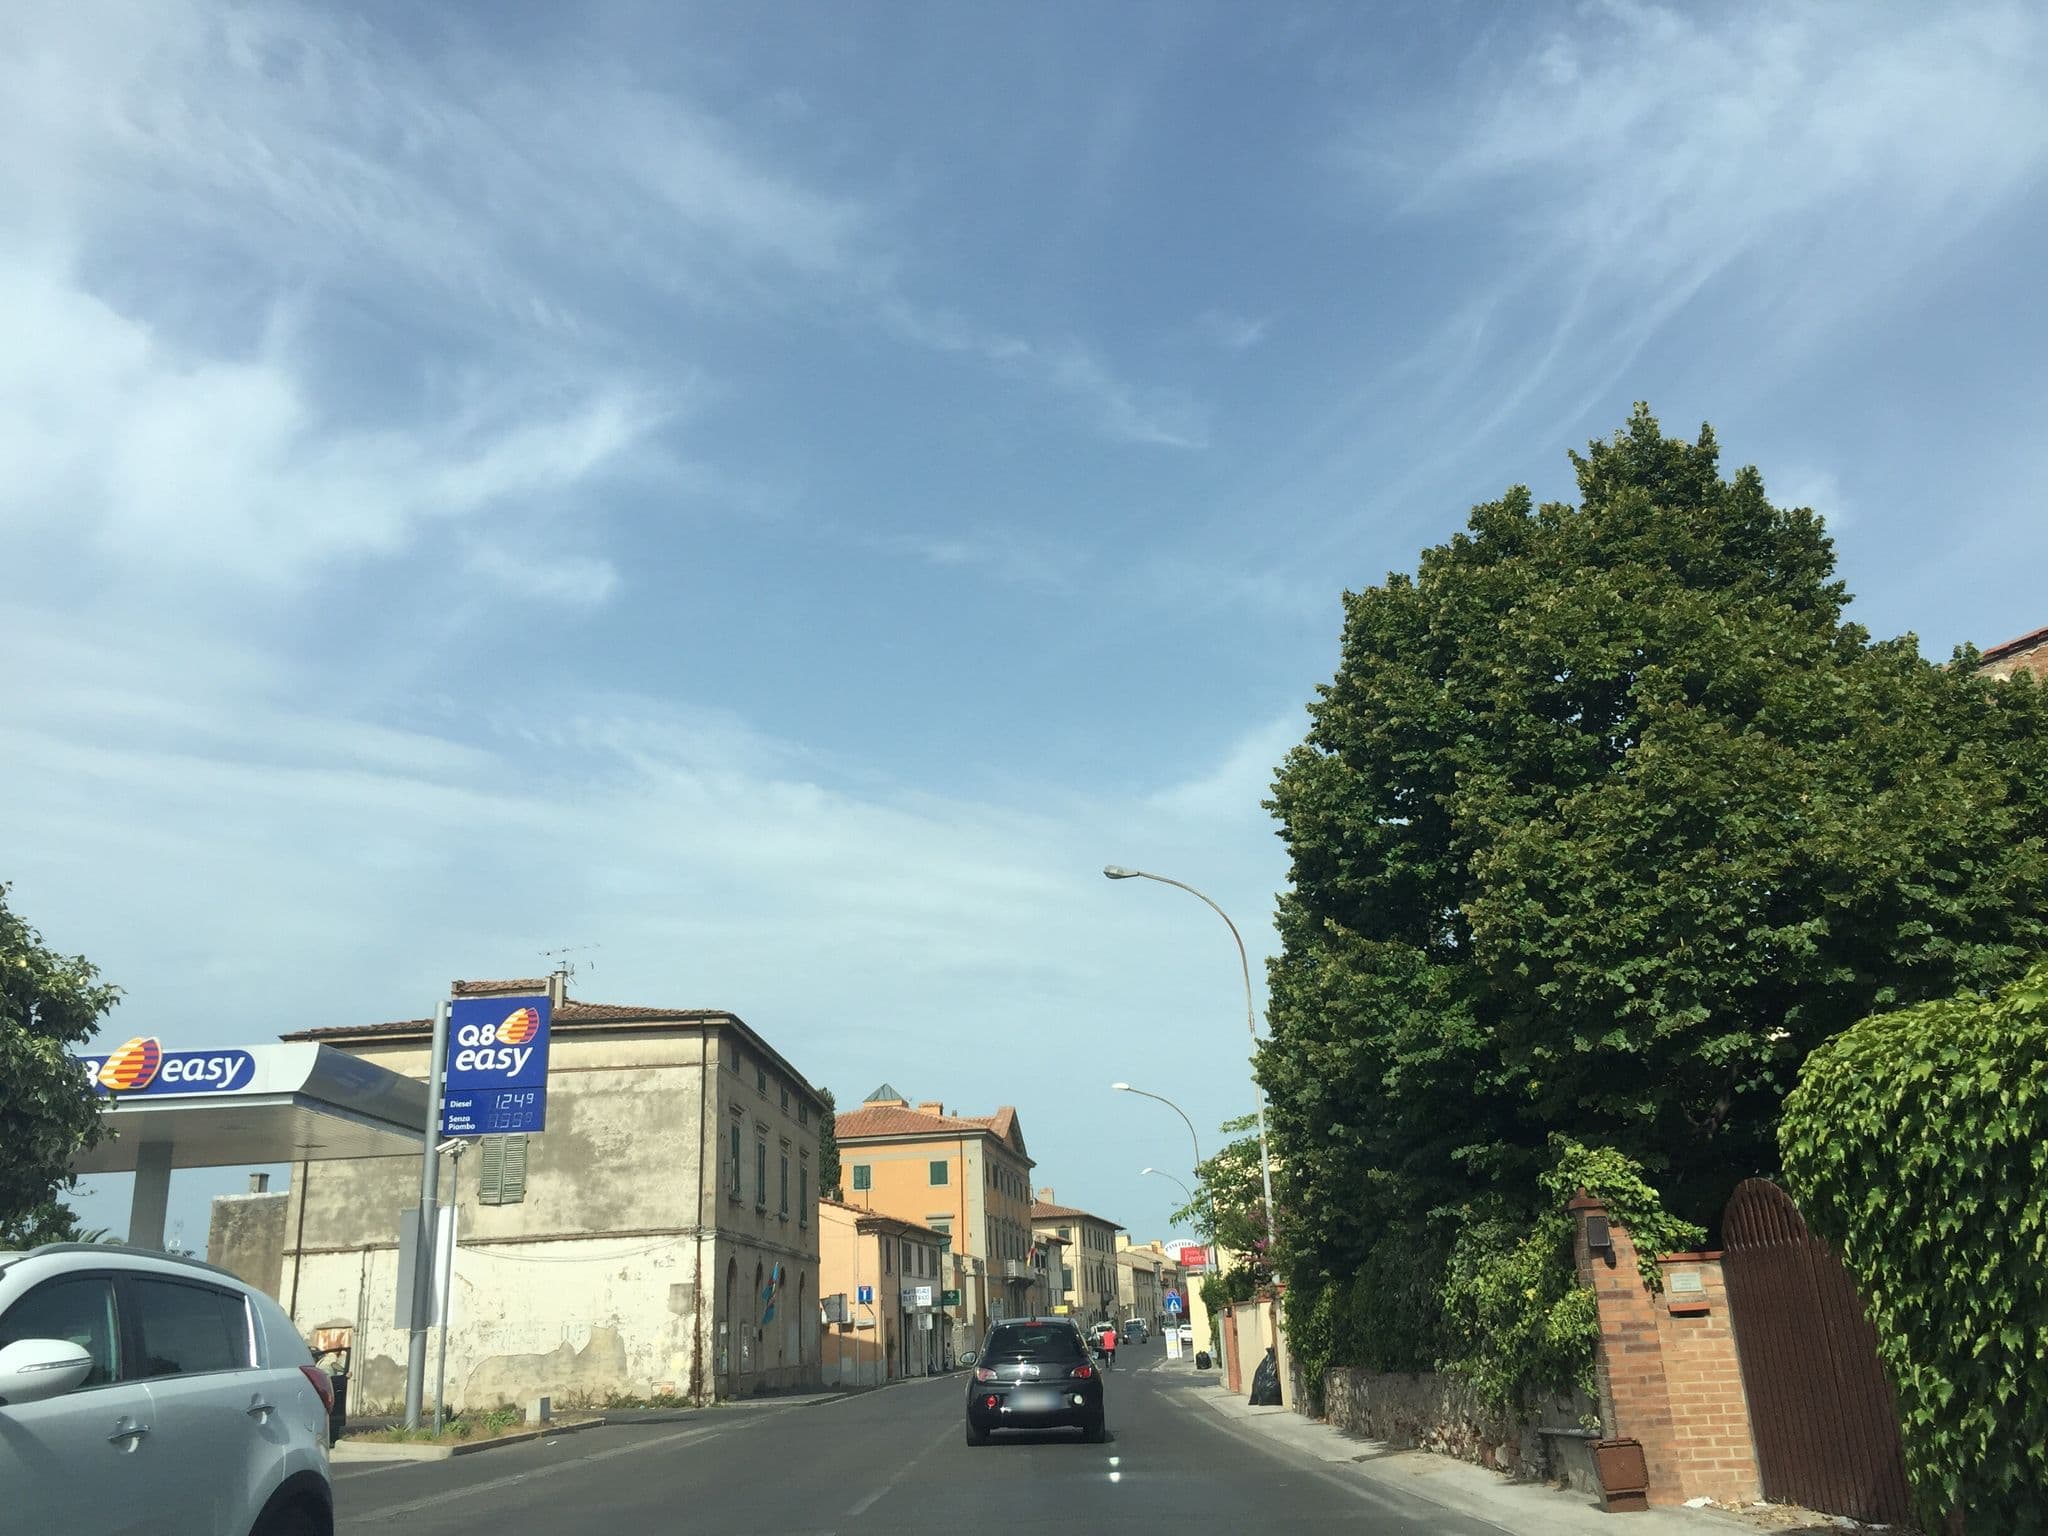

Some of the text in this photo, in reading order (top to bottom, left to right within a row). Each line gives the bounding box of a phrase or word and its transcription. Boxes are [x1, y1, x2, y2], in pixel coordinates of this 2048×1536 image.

[457, 1024, 495, 1047] Q8
[161, 1056, 246, 1088] easy
[455, 1047, 533, 1077] easy
[450, 1099, 472, 1108] Diesel
[448, 1122, 476, 1131] Piombo
